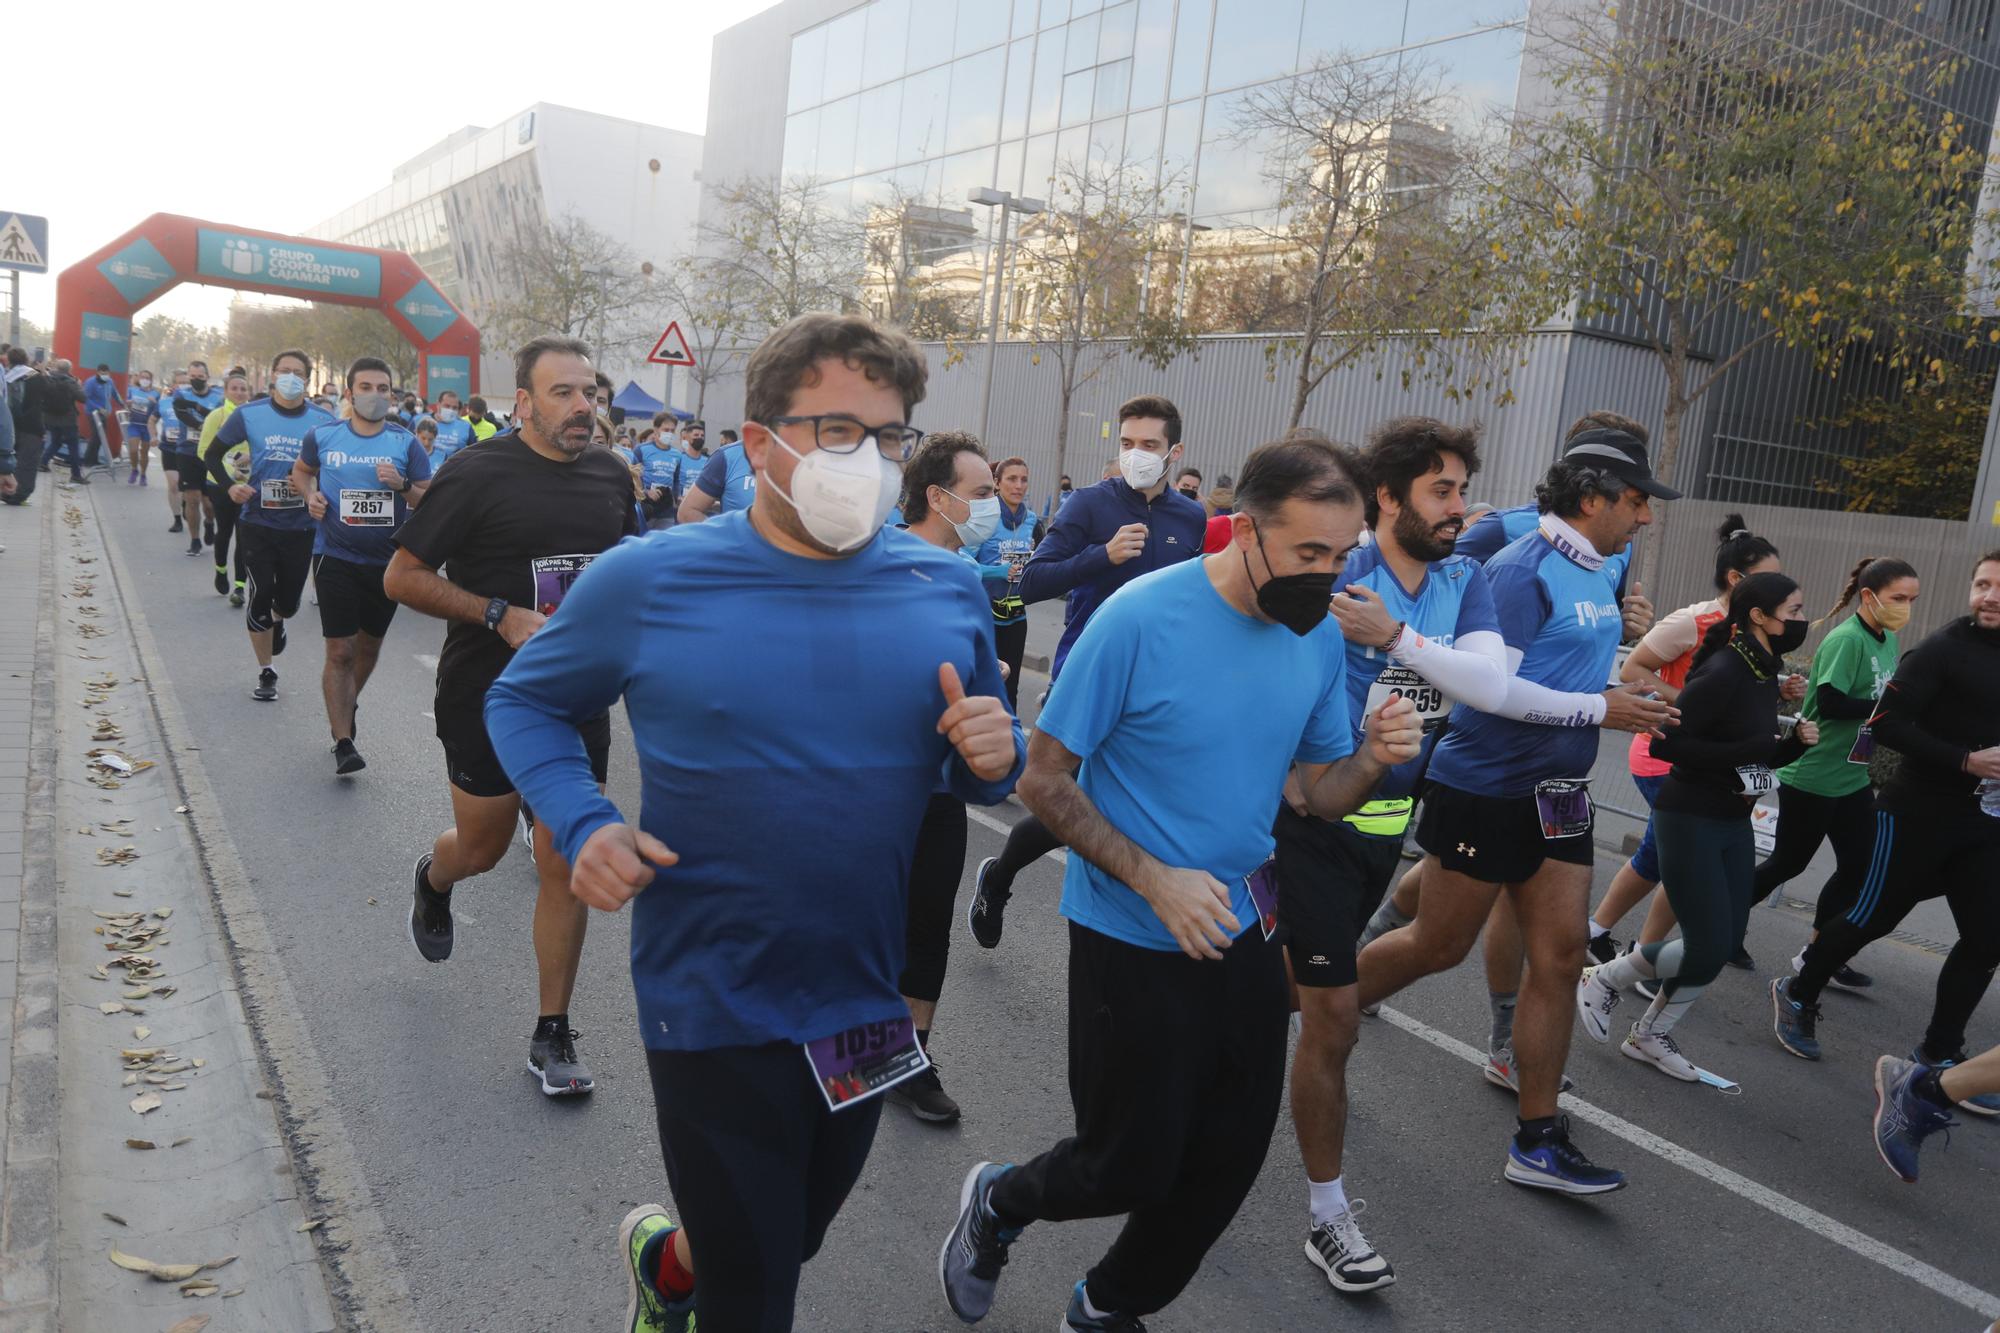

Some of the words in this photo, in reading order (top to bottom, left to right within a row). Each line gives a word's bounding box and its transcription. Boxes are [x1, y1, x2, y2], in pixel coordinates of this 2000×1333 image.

[269, 248, 315, 262] GRUPO
[269, 258, 360, 279] COOPERATIVO
[268, 268, 330, 284] CAJAMAR
[349, 456, 393, 465] MARTICO
[352, 501, 384, 514] 2857
[536, 558, 549, 568] 10K
[562, 559, 575, 567] RAS
[1524, 712, 1567, 726] MARTICO
